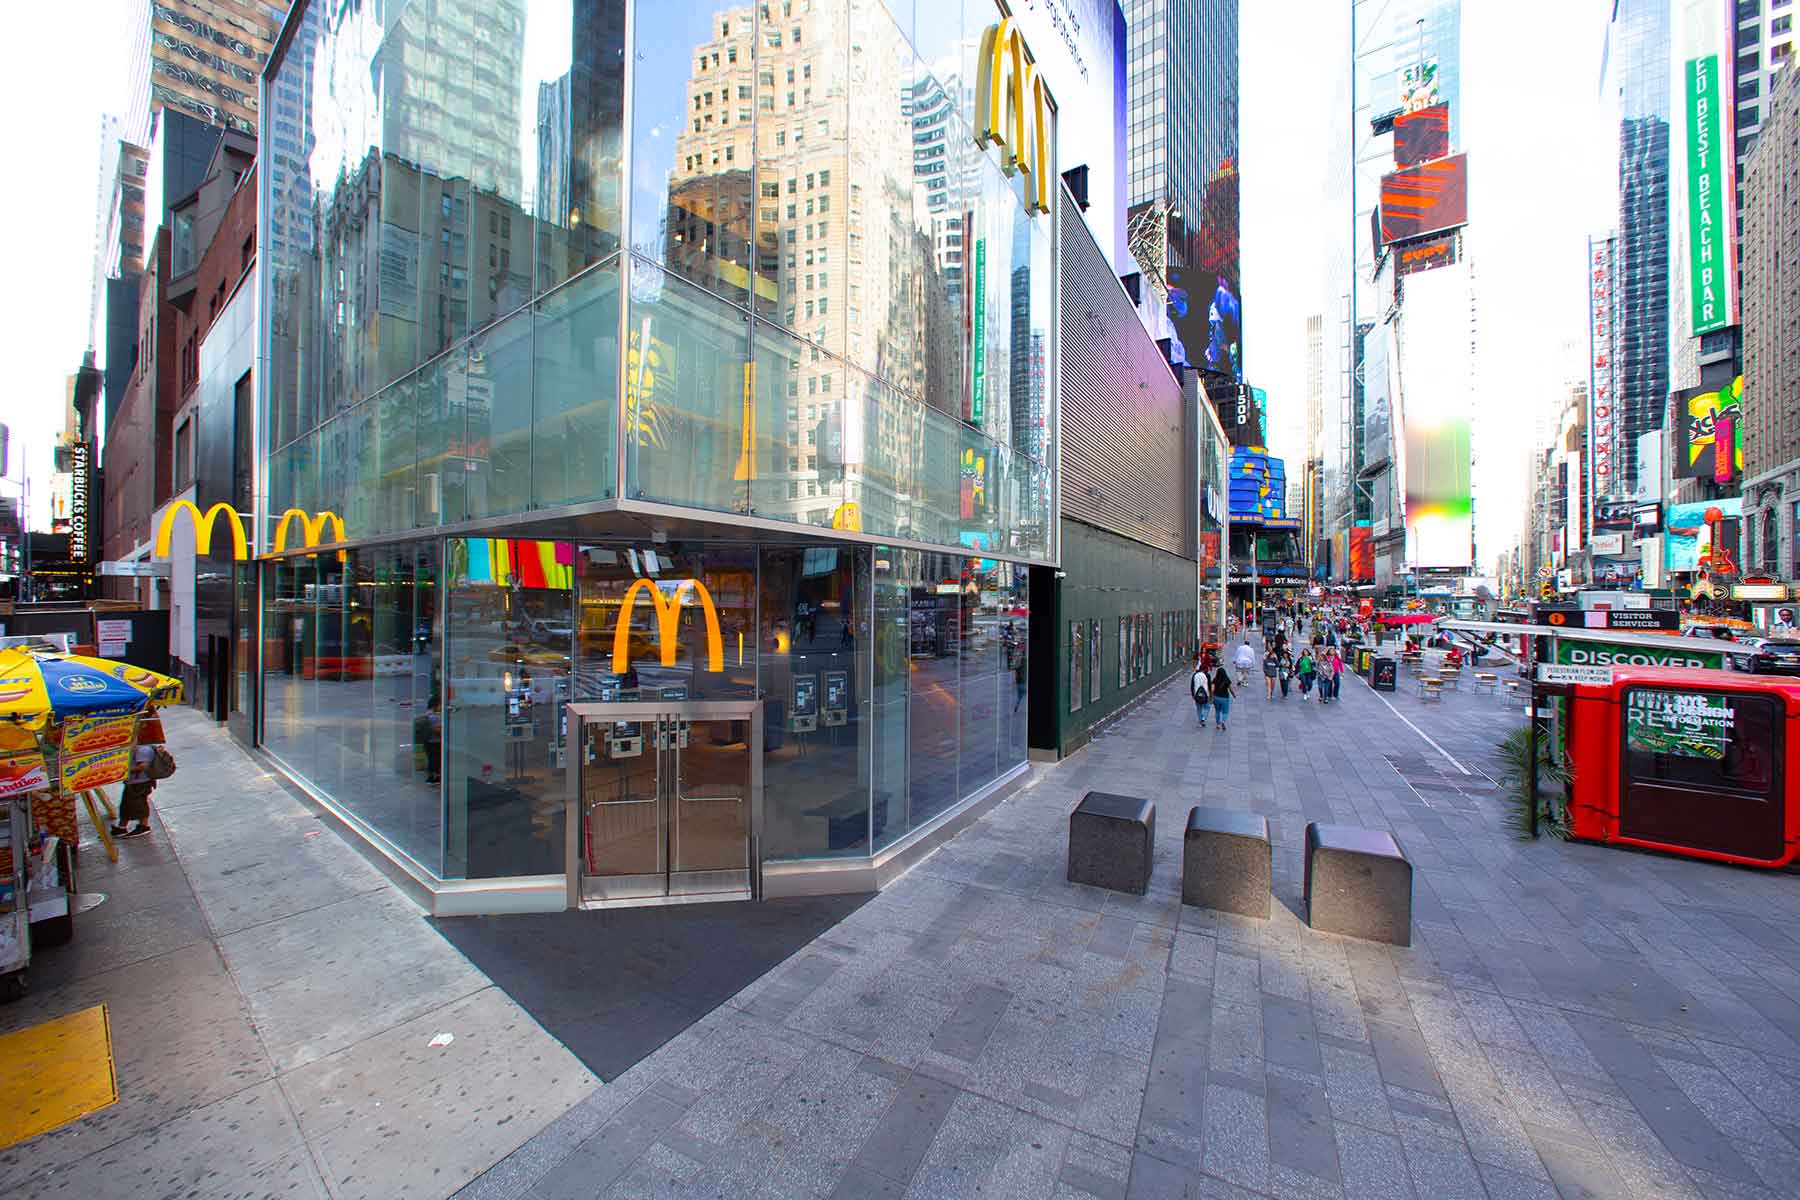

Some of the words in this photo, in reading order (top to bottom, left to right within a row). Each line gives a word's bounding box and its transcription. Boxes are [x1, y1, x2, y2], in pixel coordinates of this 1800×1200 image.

[1697, 97, 1709, 168] BEST
[1699, 173, 1712, 264] BEACH
[1702, 268, 1715, 322] BAR
[1237, 385, 1247, 425] 1500
[74, 447, 86, 514] STARBUCKS
[73, 516, 85, 558] COFFEE
